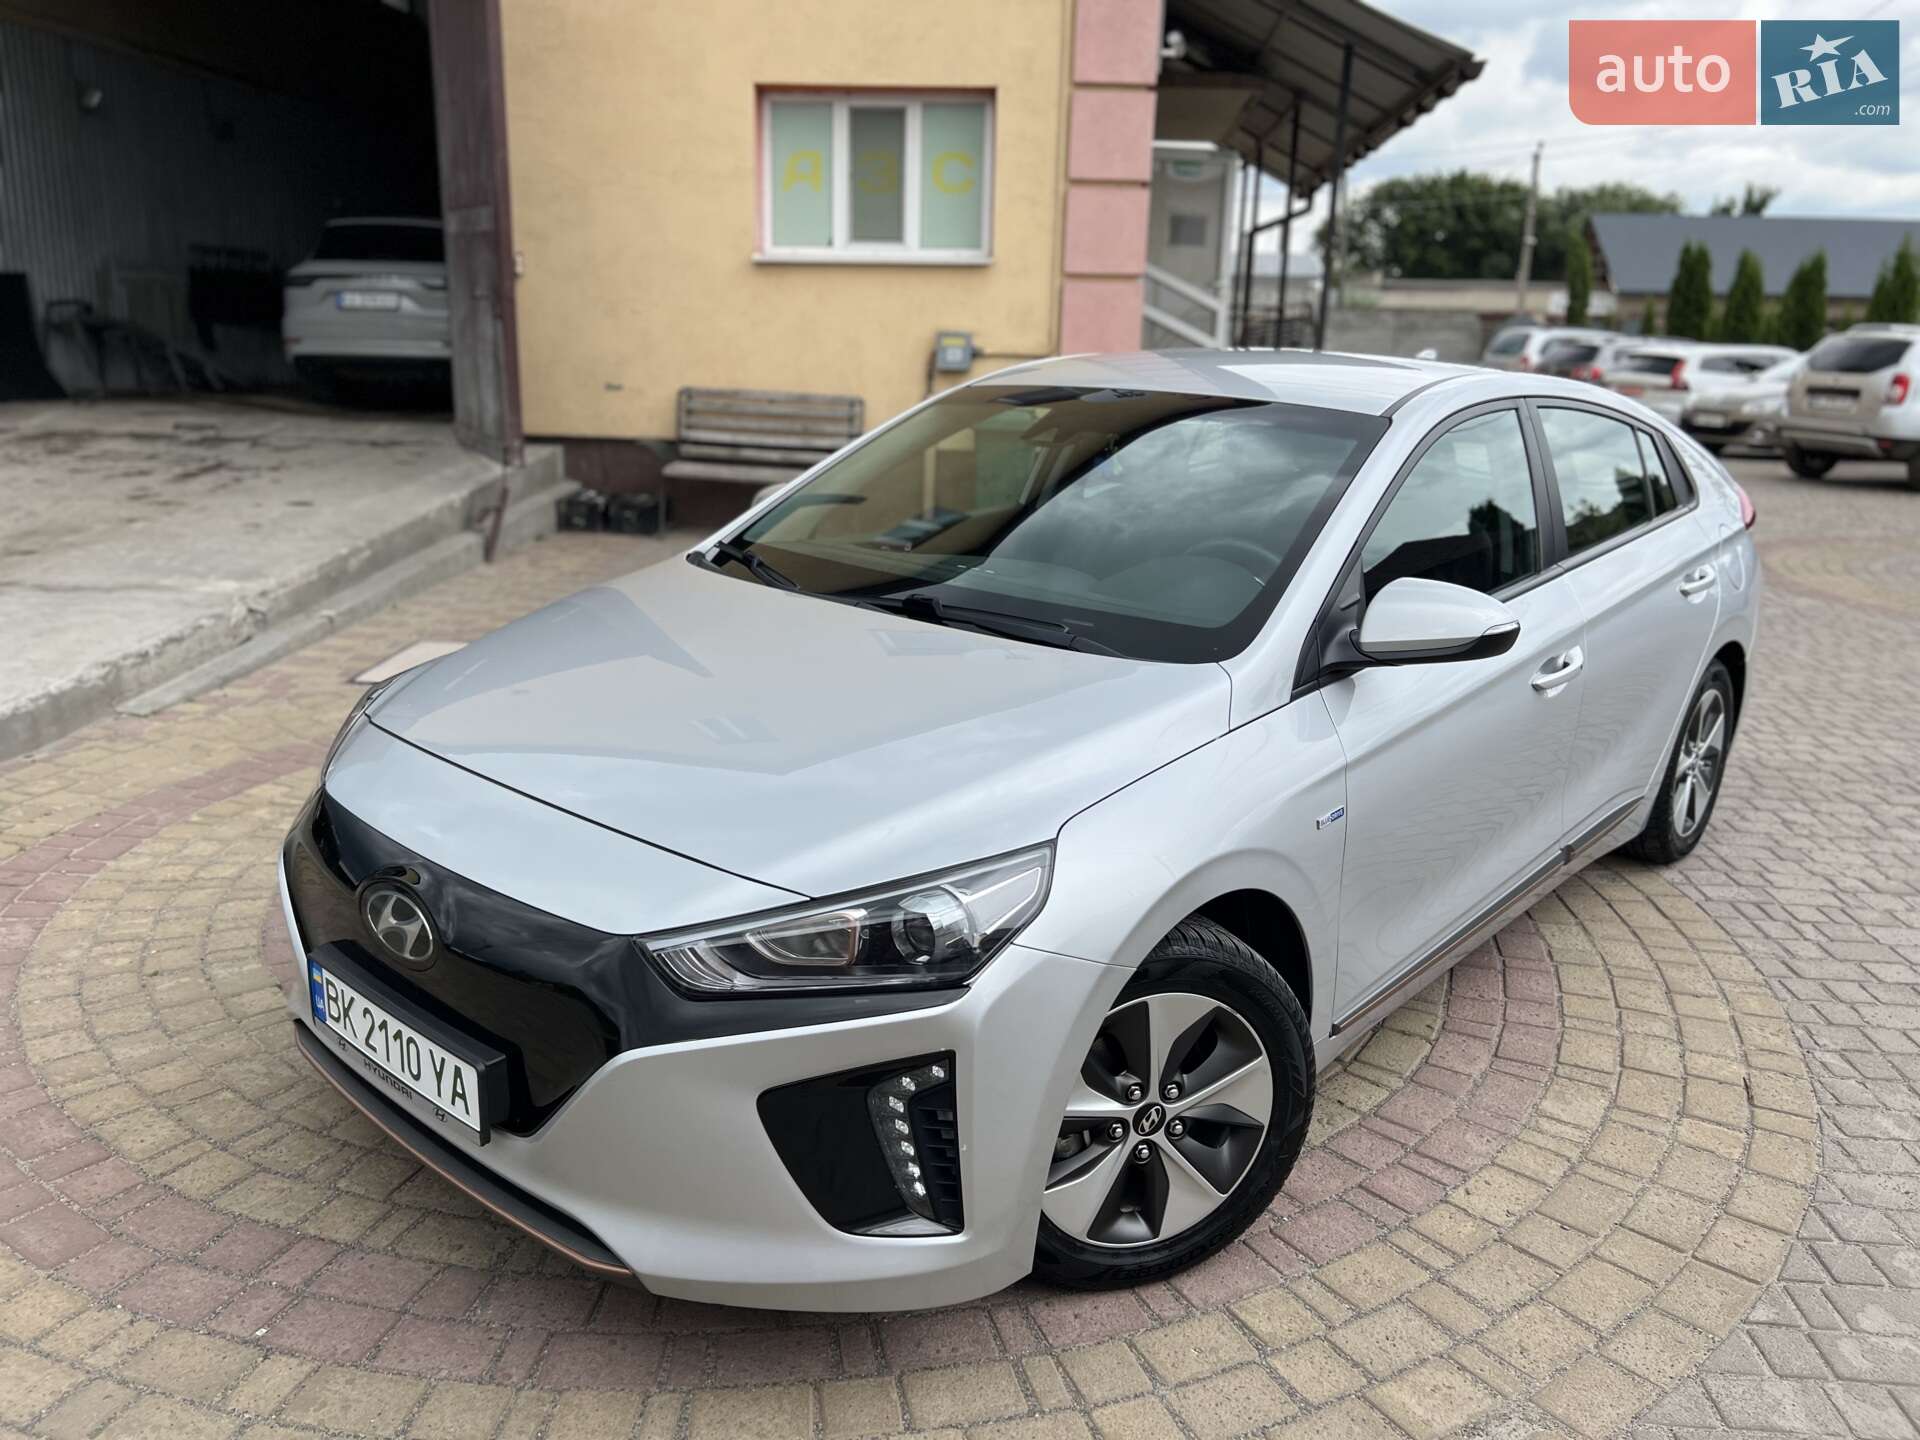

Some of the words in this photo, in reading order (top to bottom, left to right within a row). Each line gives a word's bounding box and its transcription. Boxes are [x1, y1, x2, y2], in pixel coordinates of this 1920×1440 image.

[326, 977, 358, 1039] BK
[362, 1007, 421, 1082] 2110
[429, 1049, 471, 1117] YA
[363, 1058, 413, 1100] HYUNDAI
